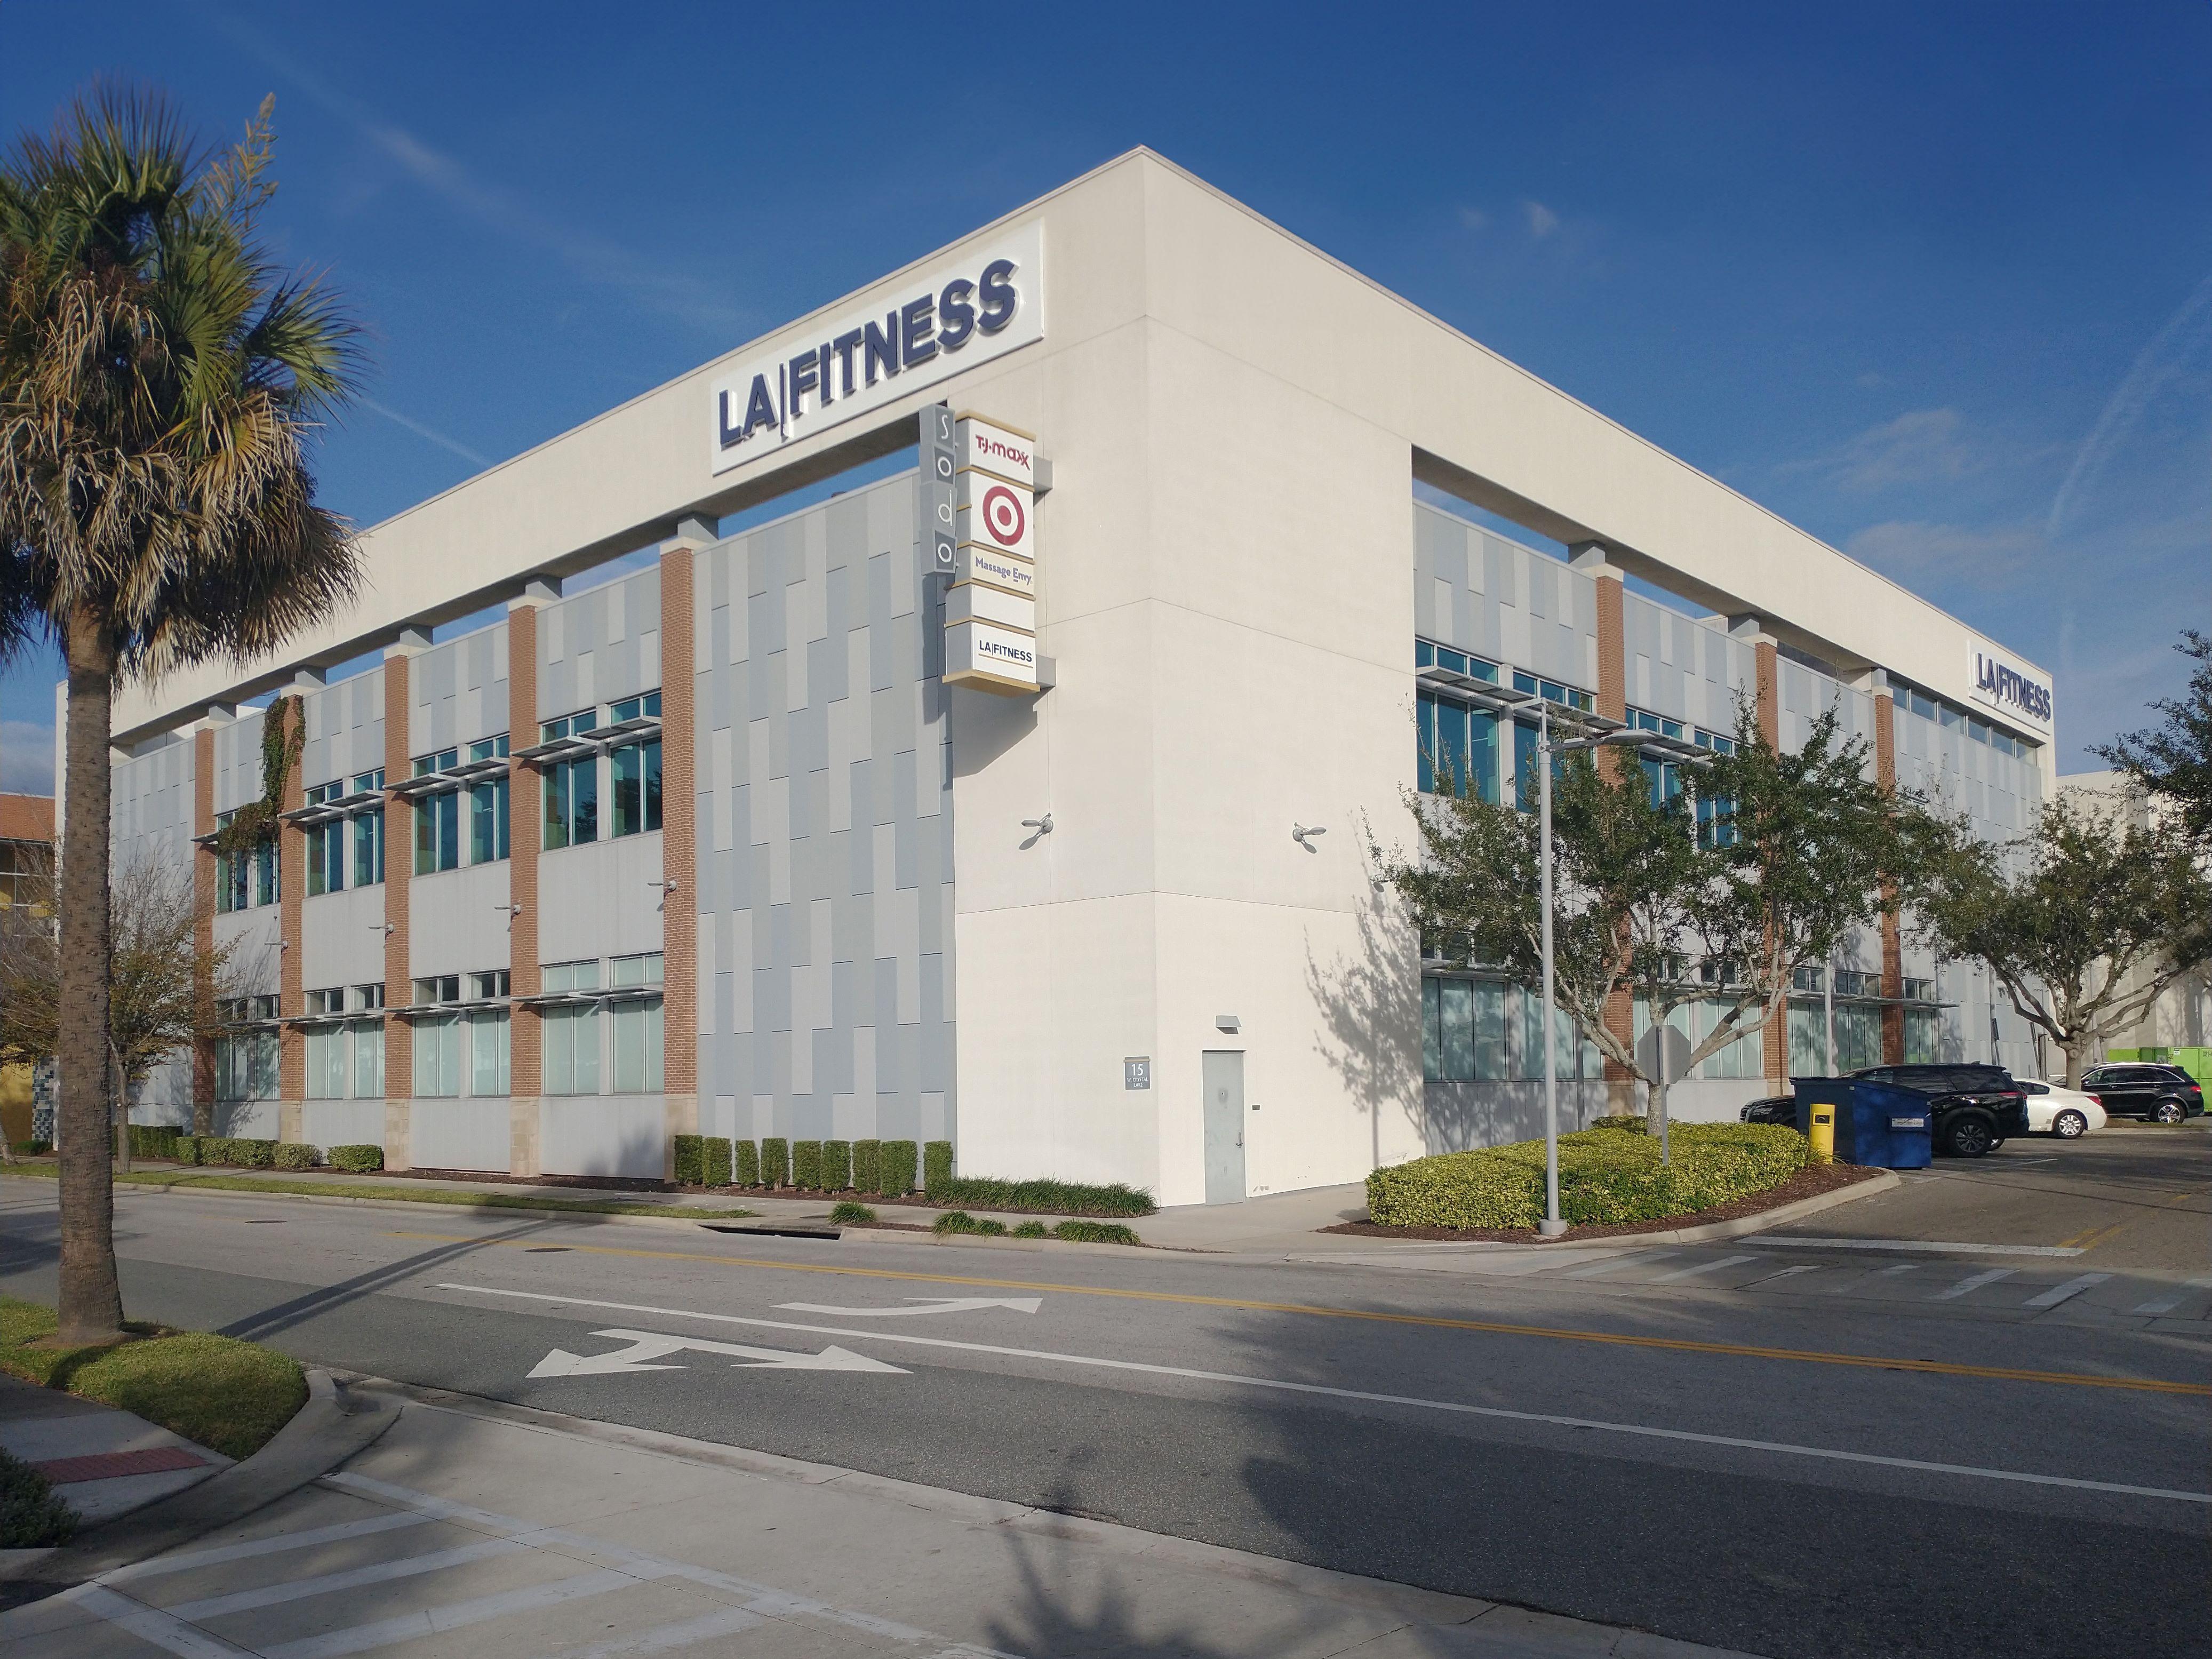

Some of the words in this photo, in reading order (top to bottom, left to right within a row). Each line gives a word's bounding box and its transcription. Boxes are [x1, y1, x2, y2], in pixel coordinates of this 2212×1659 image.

[975, 555, 1011, 579] Massage
[1013, 567, 1032, 586] Envy
[1131, 1063, 1144, 1076] 15
